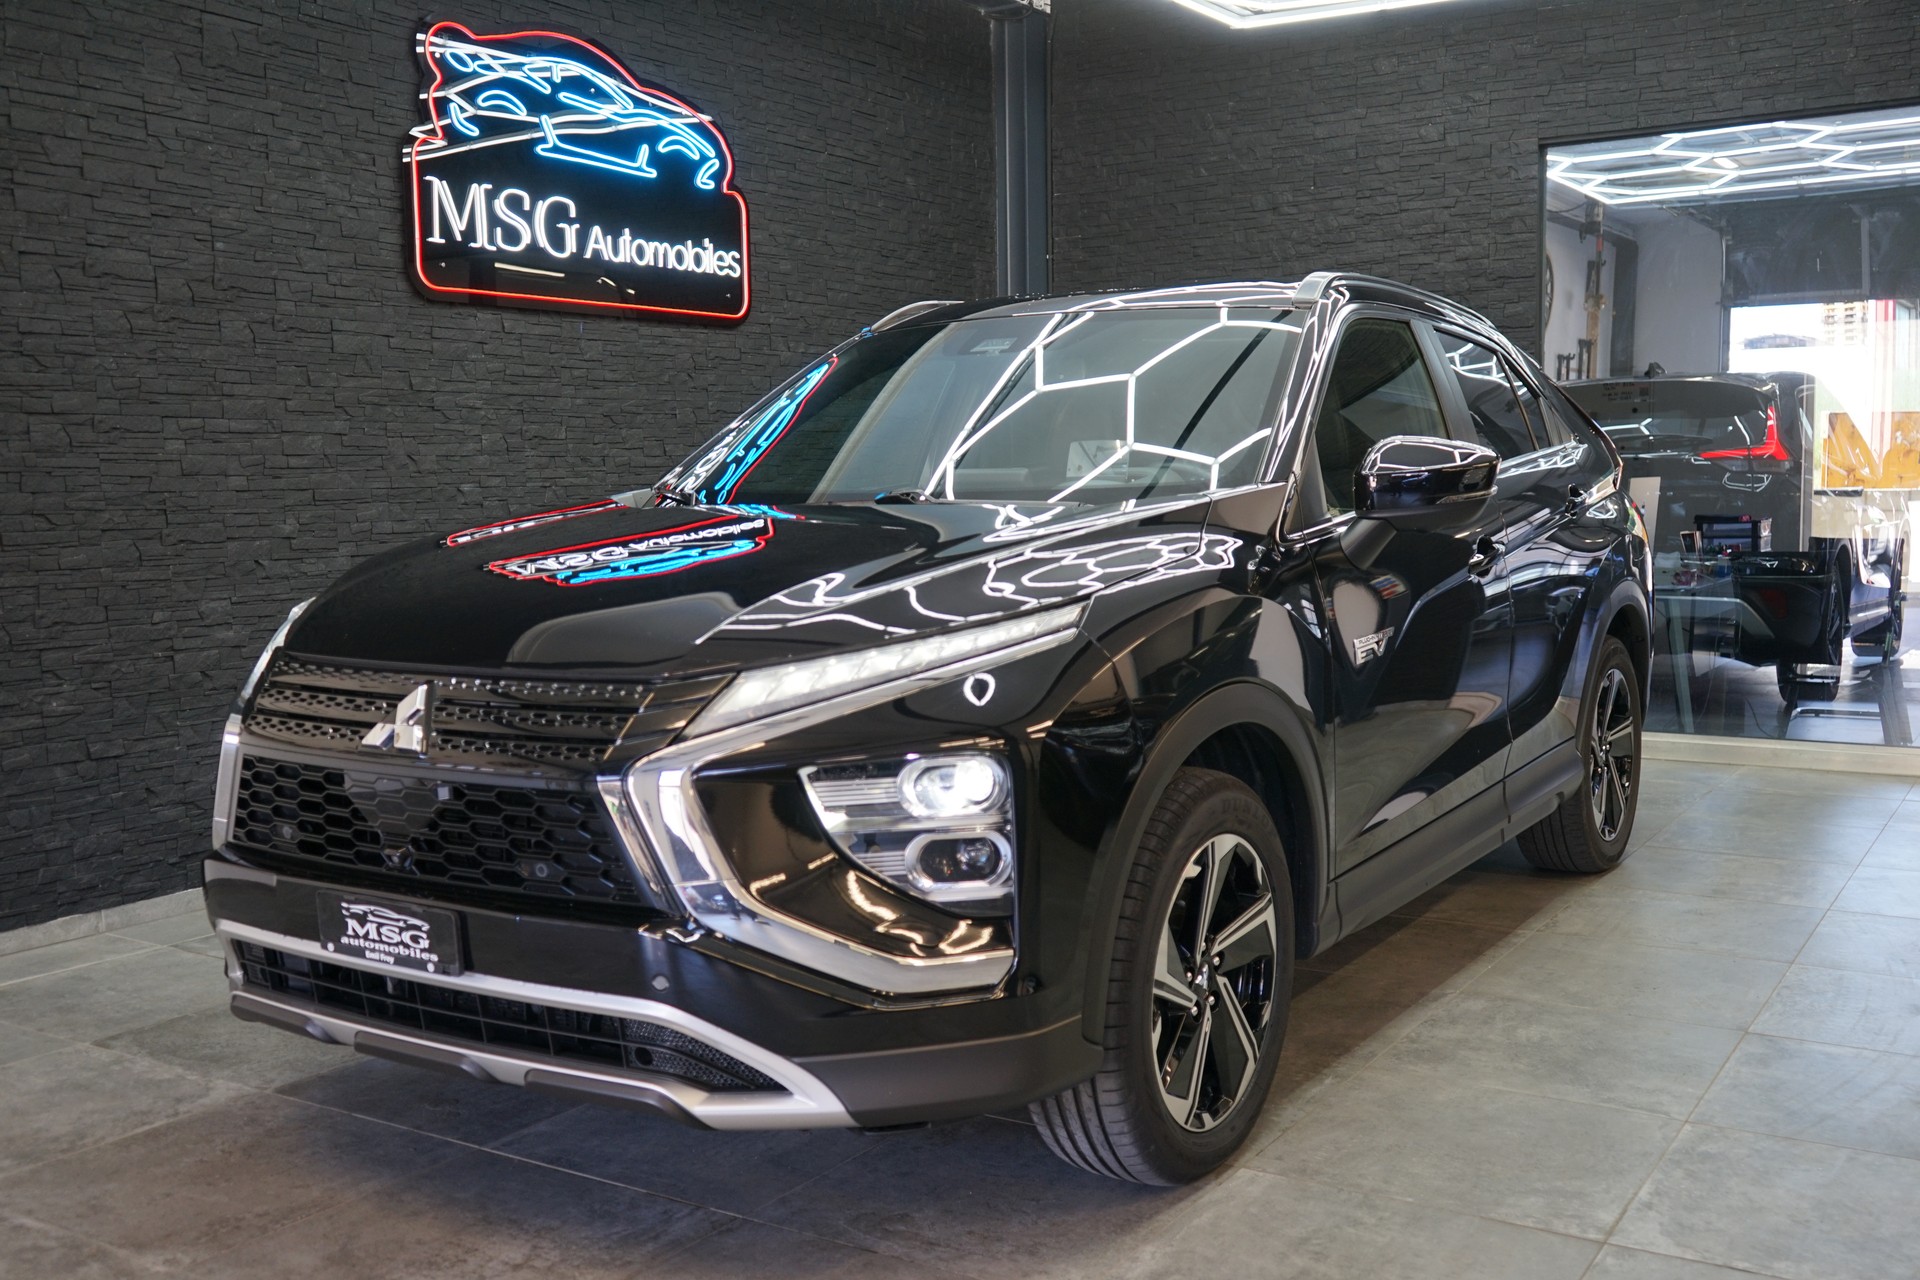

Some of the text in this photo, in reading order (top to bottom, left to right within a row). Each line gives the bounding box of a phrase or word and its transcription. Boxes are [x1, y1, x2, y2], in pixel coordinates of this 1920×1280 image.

[422, 175, 742, 278] MSG Automobiles
[1354, 639, 1387, 665] EV
[345, 918, 430, 948] MSG
[340, 936, 439, 962] automobiles
